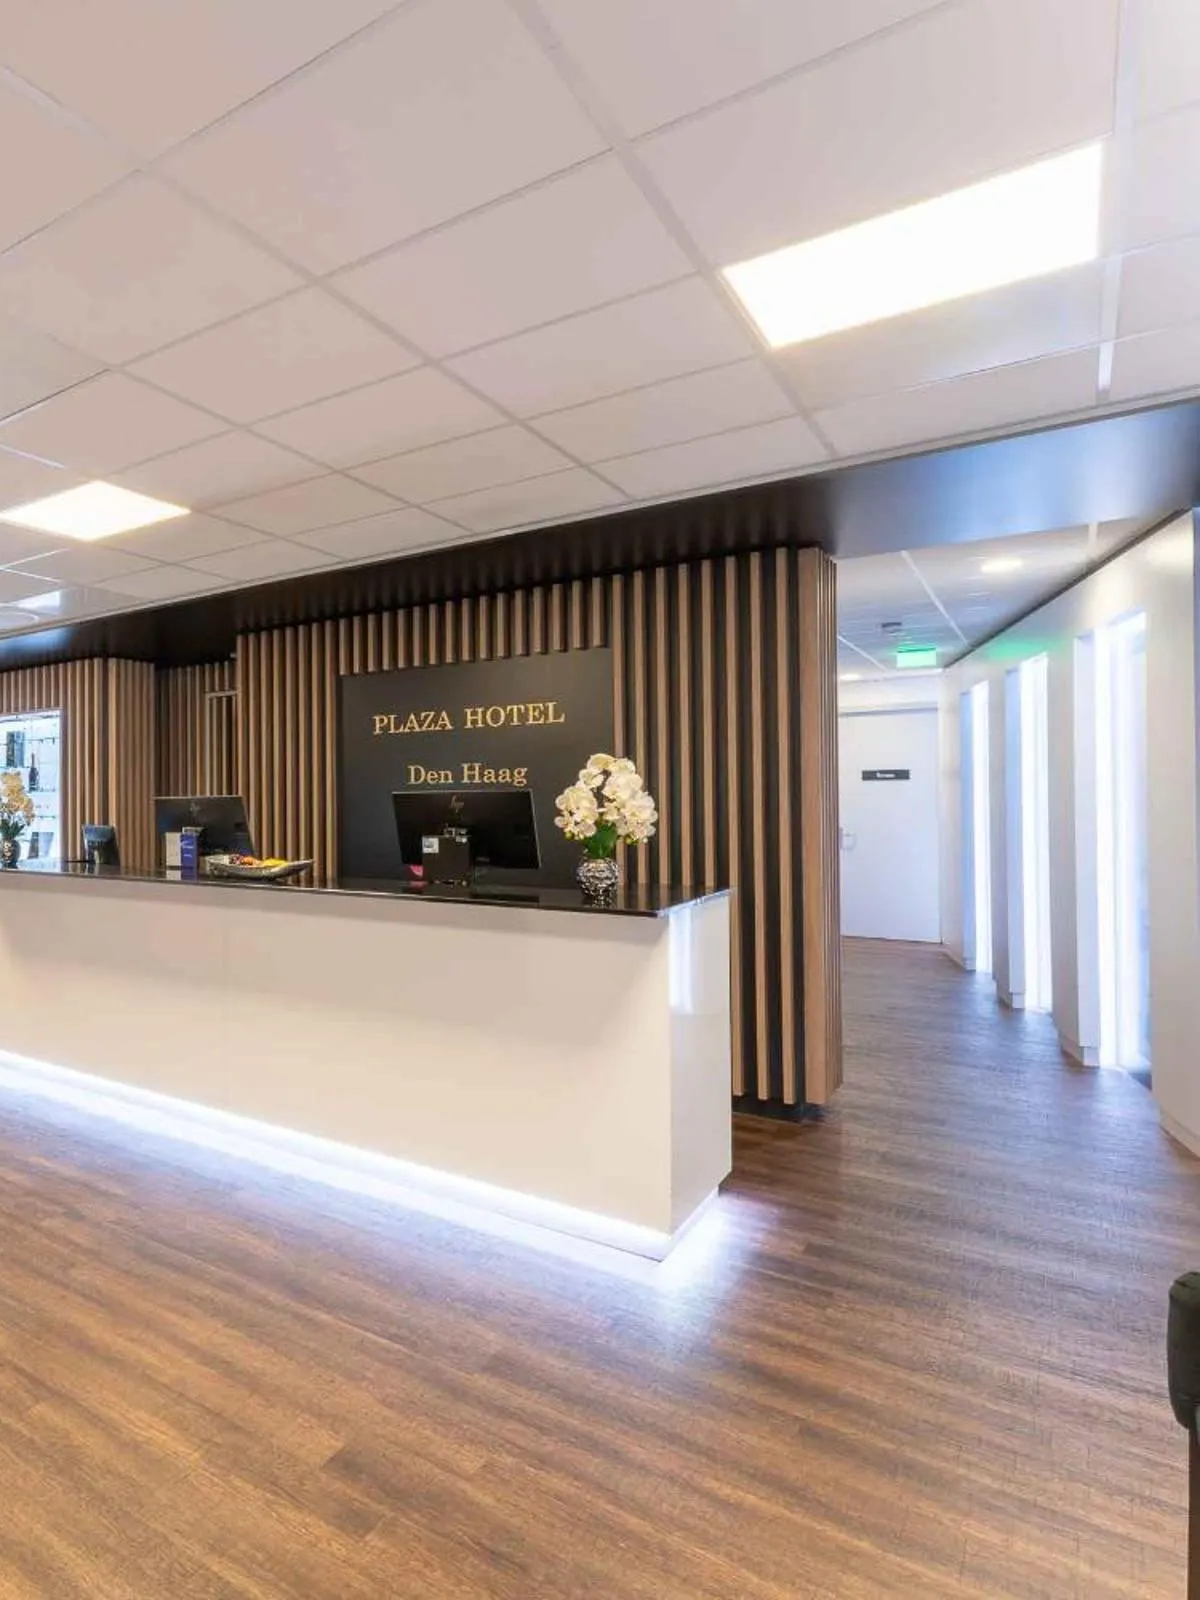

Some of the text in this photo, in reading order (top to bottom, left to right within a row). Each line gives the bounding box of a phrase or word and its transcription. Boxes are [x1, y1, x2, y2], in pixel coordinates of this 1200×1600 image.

[373, 702, 566, 735] PLAZA HOTEL
[408, 763, 528, 786] Den Haag
